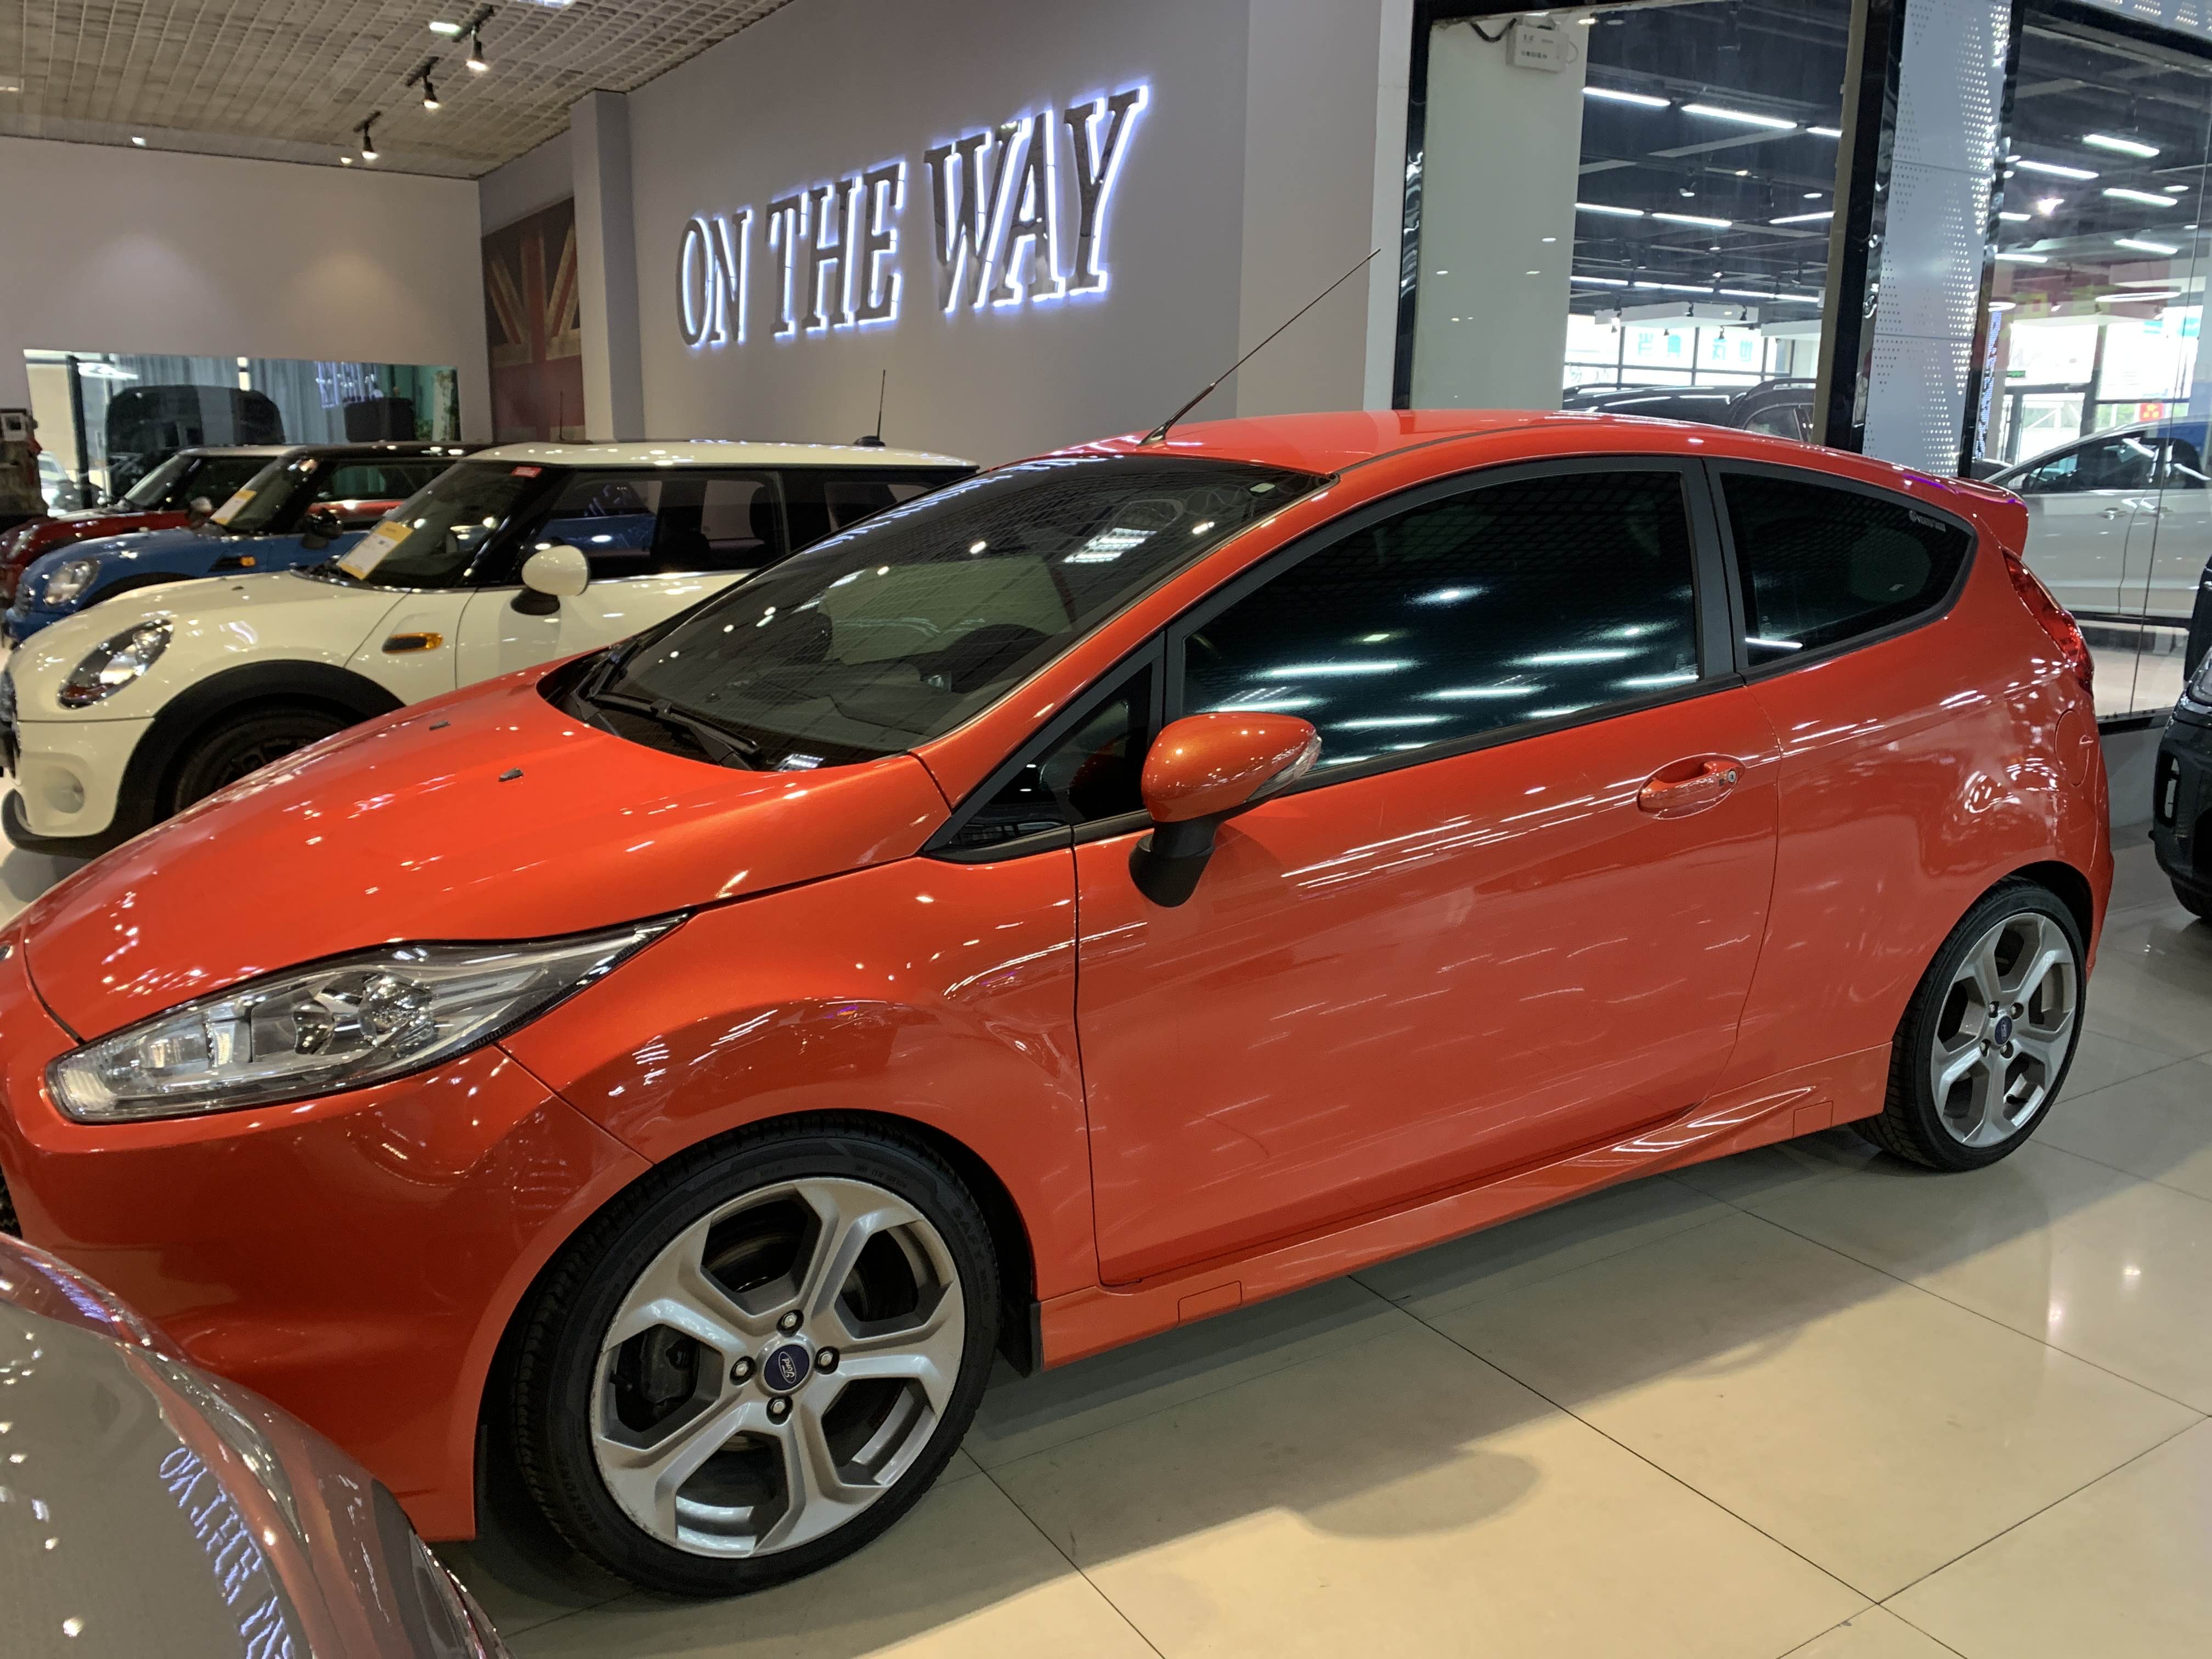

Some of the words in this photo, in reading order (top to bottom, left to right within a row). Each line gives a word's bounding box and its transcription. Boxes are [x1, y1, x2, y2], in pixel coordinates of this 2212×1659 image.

[676, 209, 753, 346] ON
[766, 161, 905, 337] THE
[923, 84, 1149, 313] WAY
[781, 1357, 795, 1379] Ford
